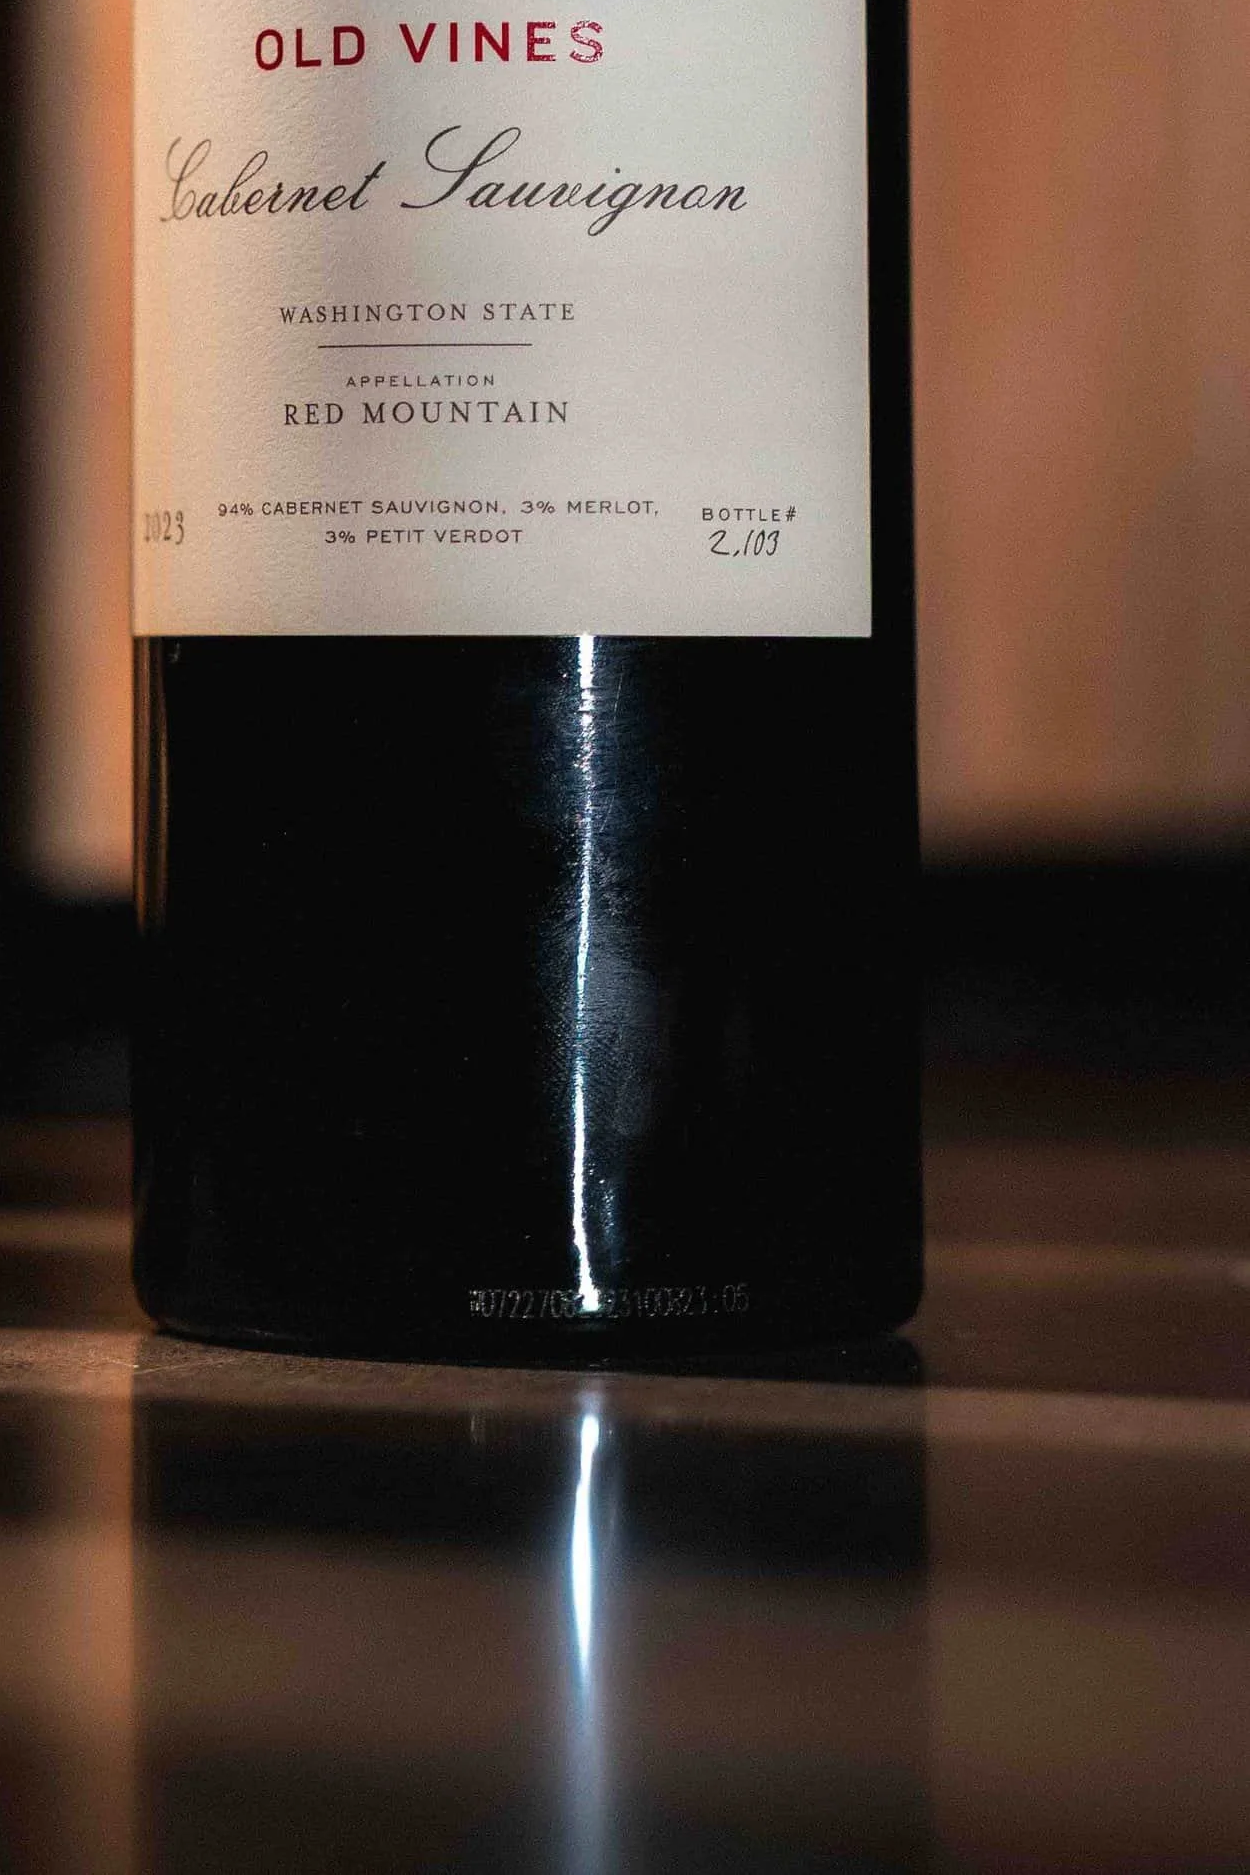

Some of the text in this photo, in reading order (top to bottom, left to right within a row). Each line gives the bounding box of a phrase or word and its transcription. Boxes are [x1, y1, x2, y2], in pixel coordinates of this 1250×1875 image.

[254, 19, 605, 72] OLD VINES
[158, 124, 748, 237] Cabernet Sauvignon
[278, 301, 576, 325] WASHINGTON STATE
[345, 373, 496, 388] APPELLATION
[283, 400, 571, 426] RED MOUNTAIN
[217, 501, 255, 518] 94%
[261, 499, 364, 516] CABERNET
[520, 500, 557, 515] 3%
[567, 499, 660, 518] MERLOT,
[701, 504, 798, 522] BOTTLE#
[324, 528, 524, 545] 3% PETIT VERDOT
